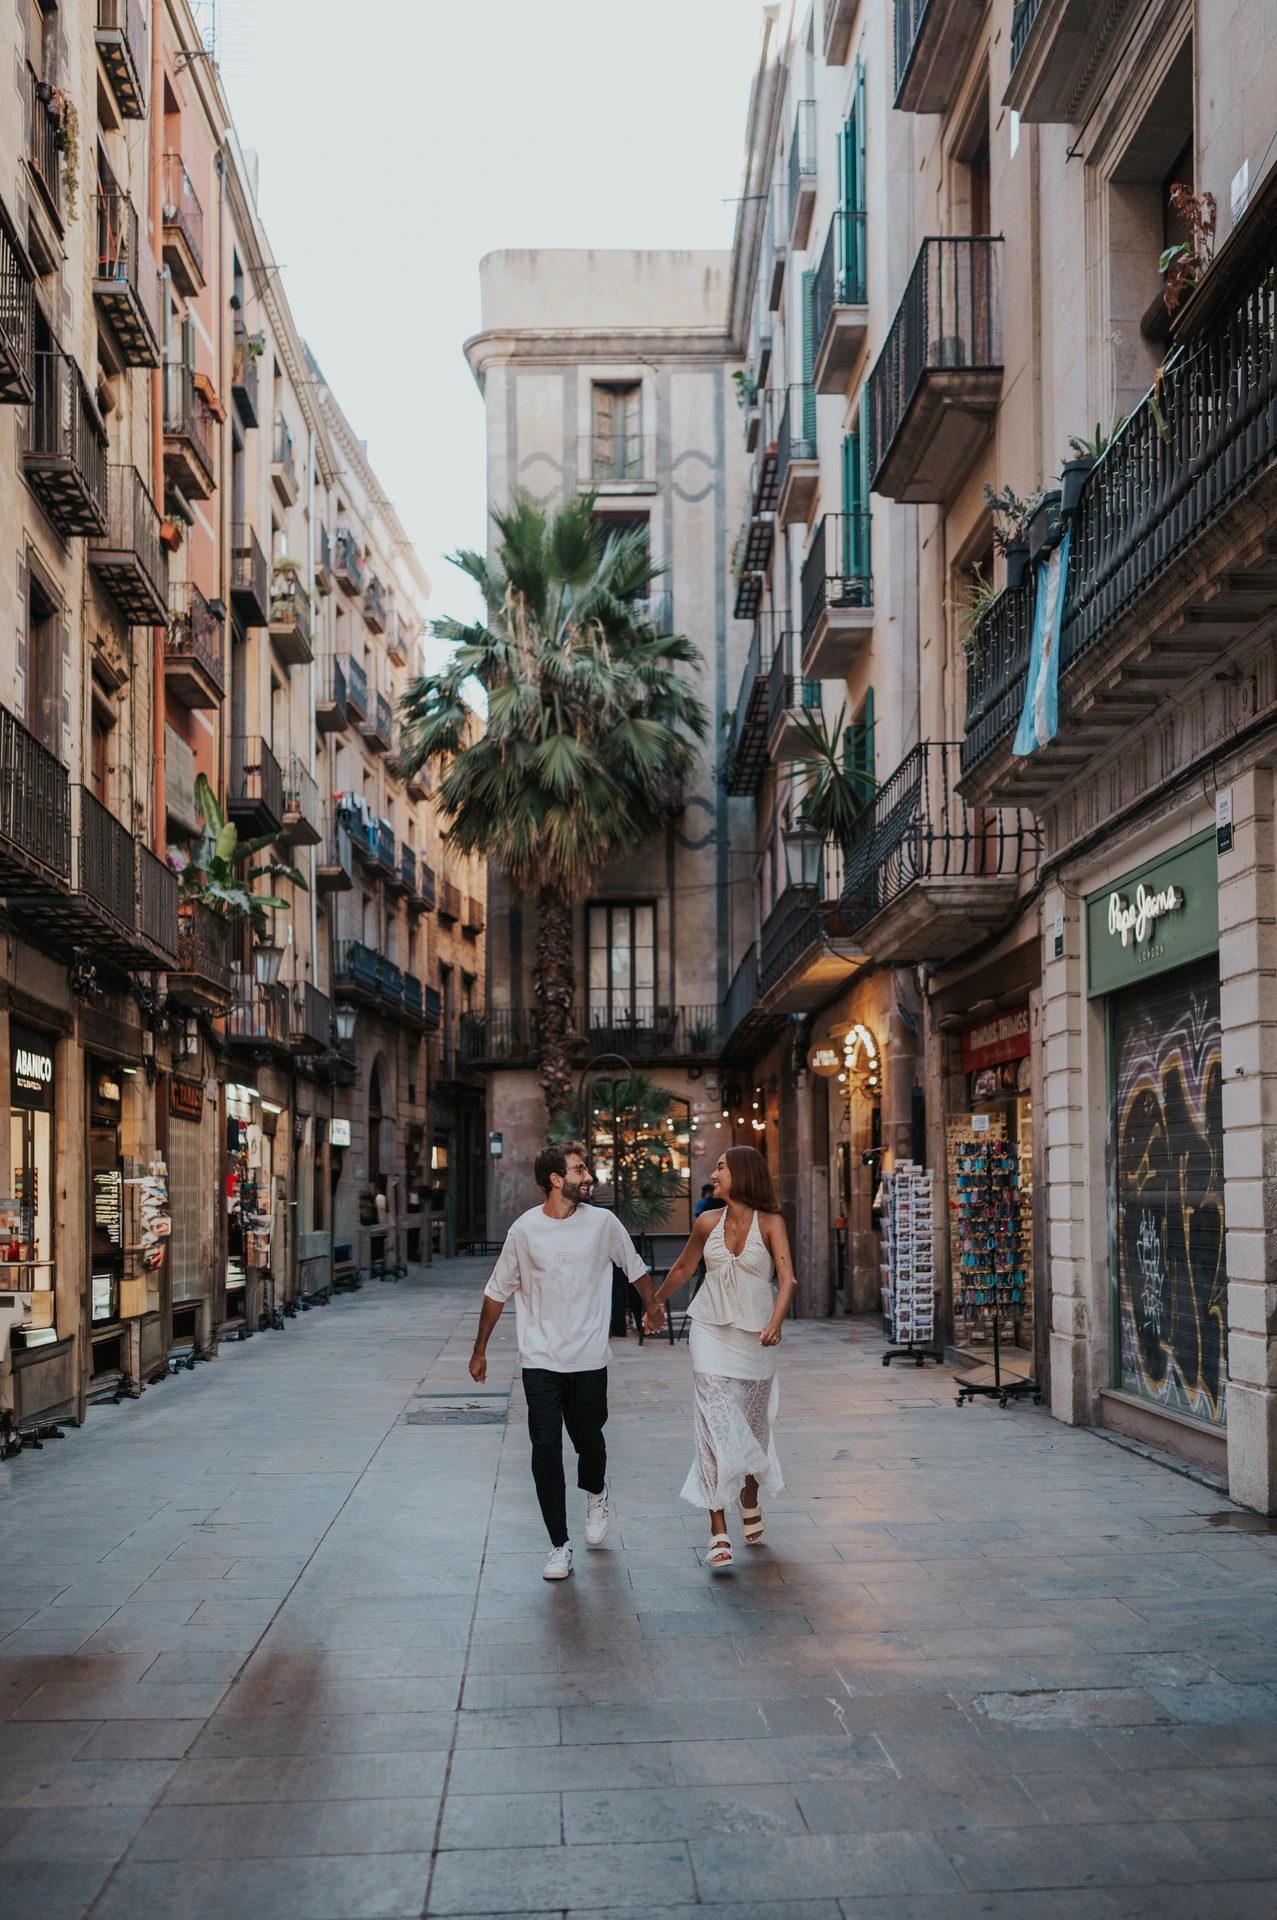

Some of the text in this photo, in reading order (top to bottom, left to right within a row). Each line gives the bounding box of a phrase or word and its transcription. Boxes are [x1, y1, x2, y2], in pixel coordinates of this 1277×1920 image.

[1108, 884, 1177, 947] Pepe Jeans
[1139, 943, 1164, 963] LONDON
[998, 1010, 1029, 1041] THINGS
[15, 1049, 52, 1083] ABANICO
